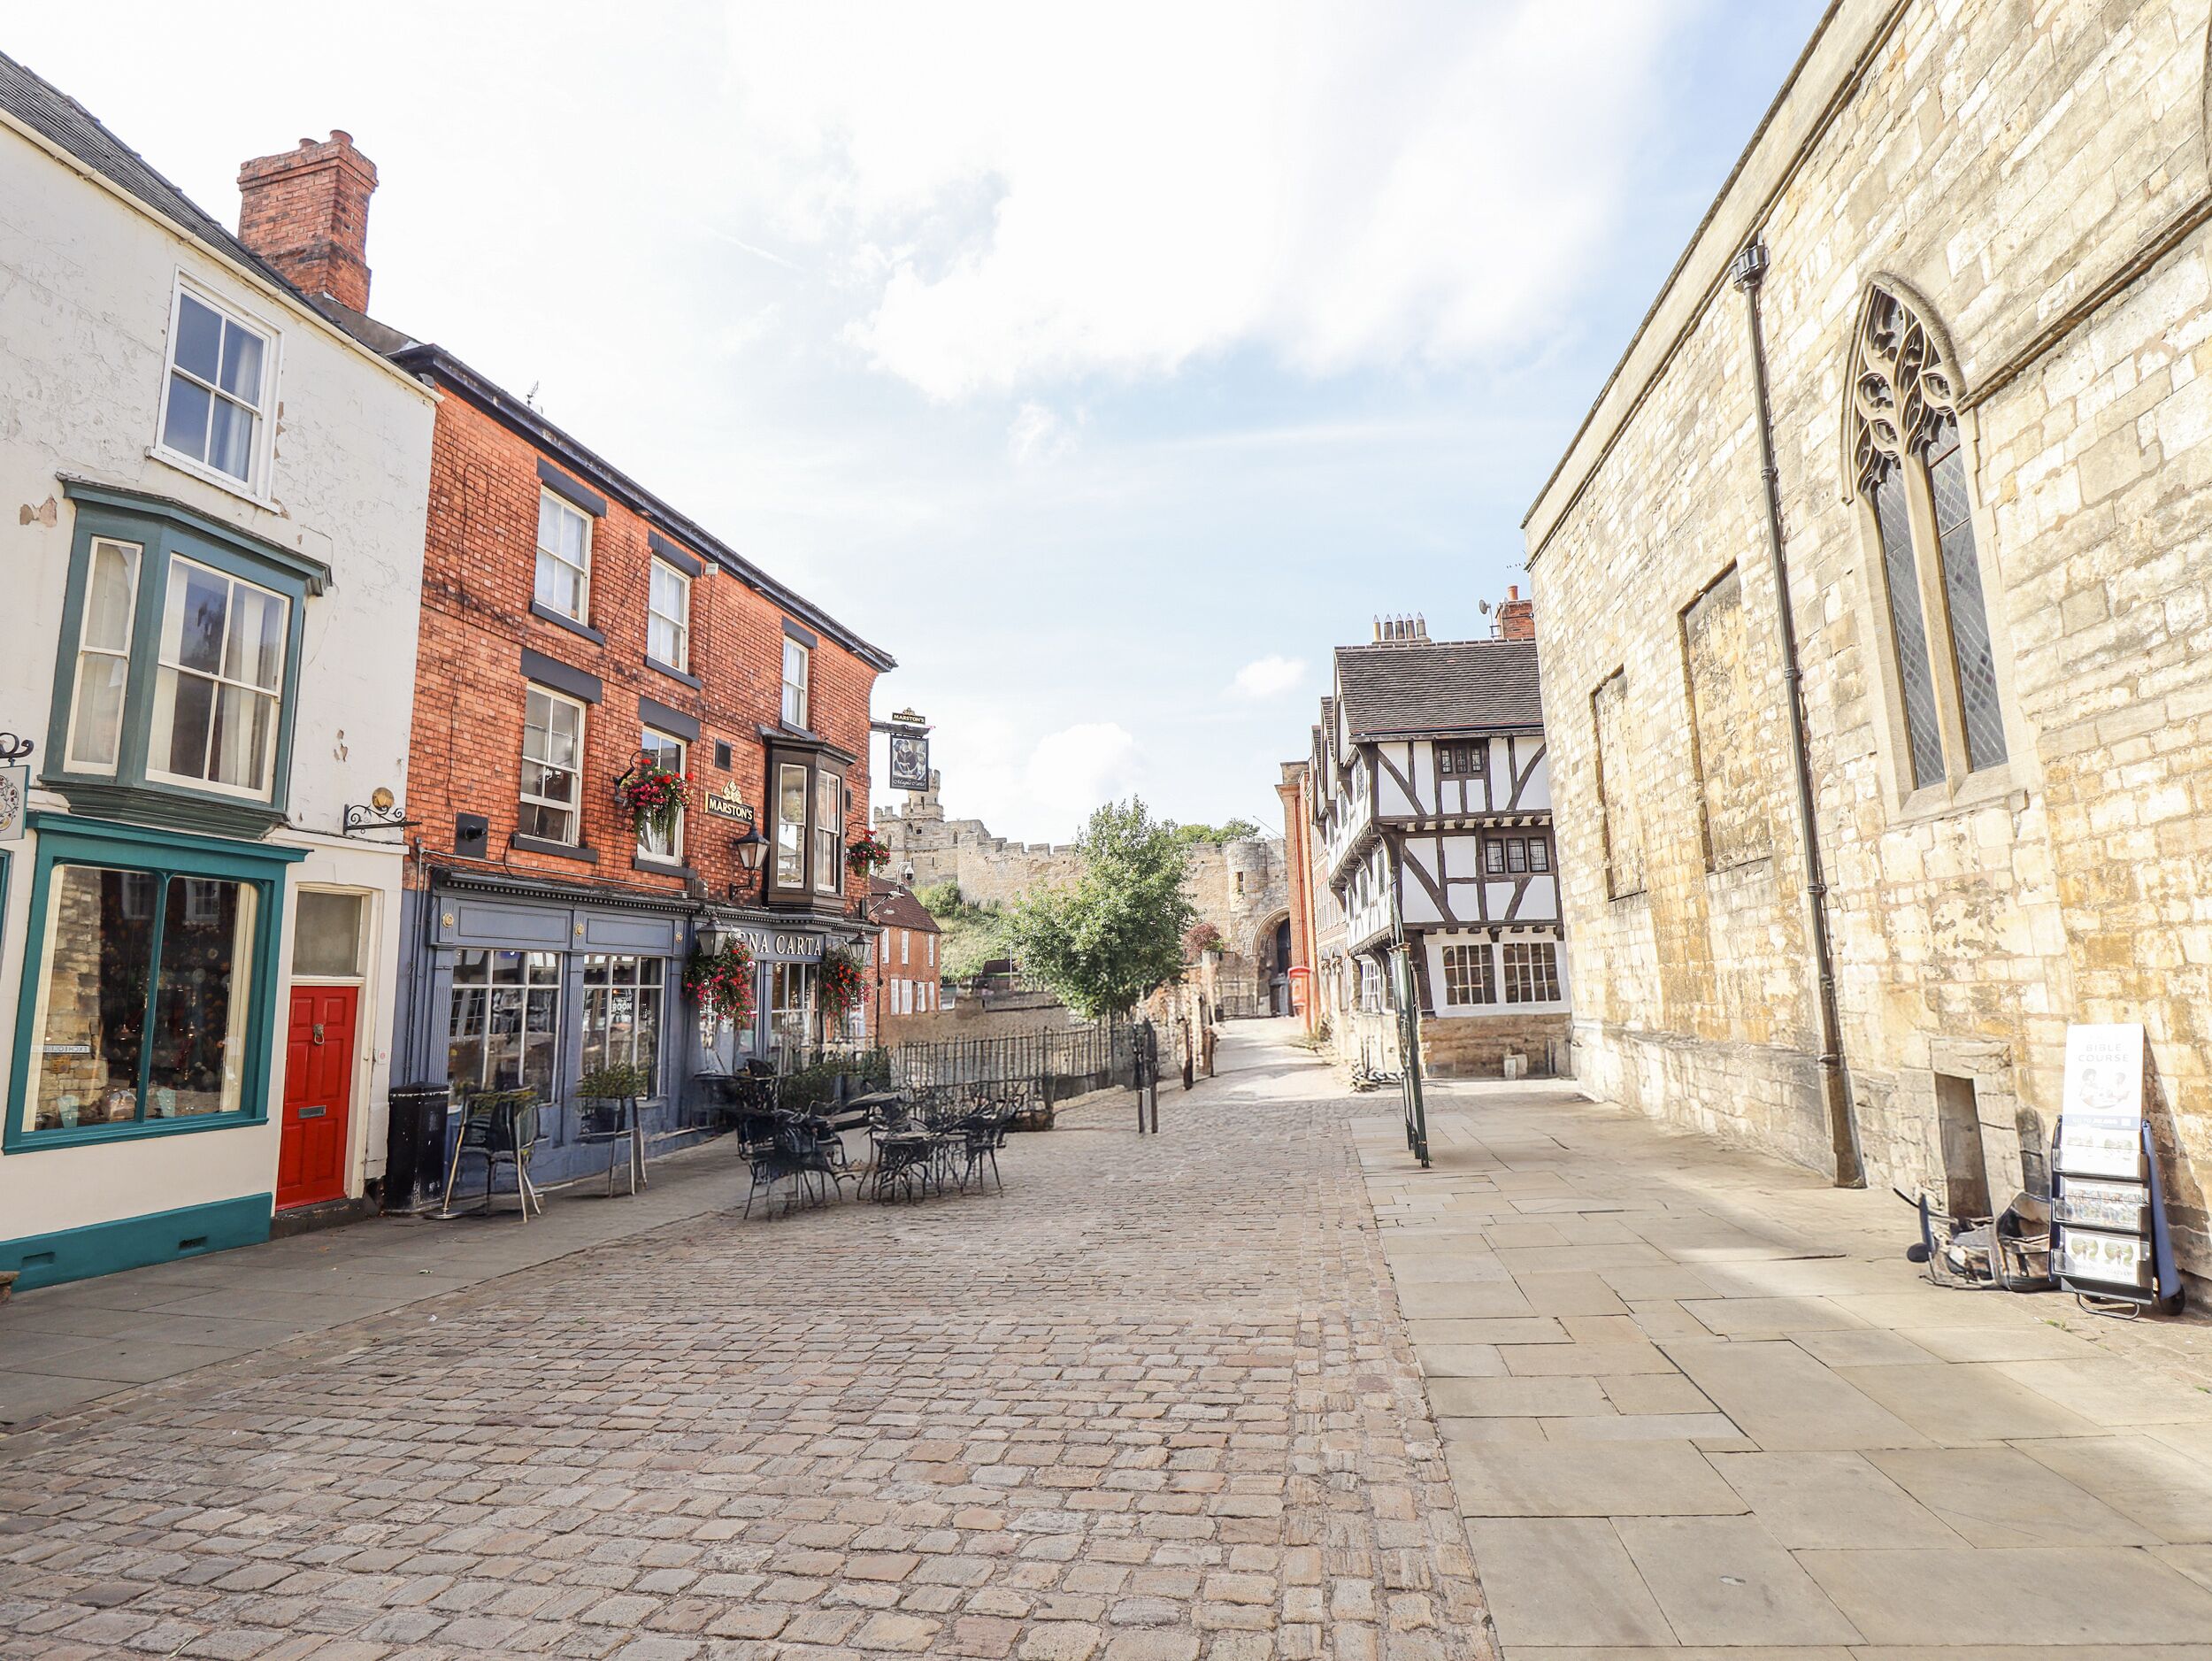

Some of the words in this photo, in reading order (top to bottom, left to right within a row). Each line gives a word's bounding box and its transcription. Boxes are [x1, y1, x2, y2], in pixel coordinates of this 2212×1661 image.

[709, 798, 753, 820] MARSTON'S
[776, 934, 822, 956] CARTA
[2085, 1042, 2123, 1052] BIBLE
[2078, 1053, 2130, 1063] COURSE
